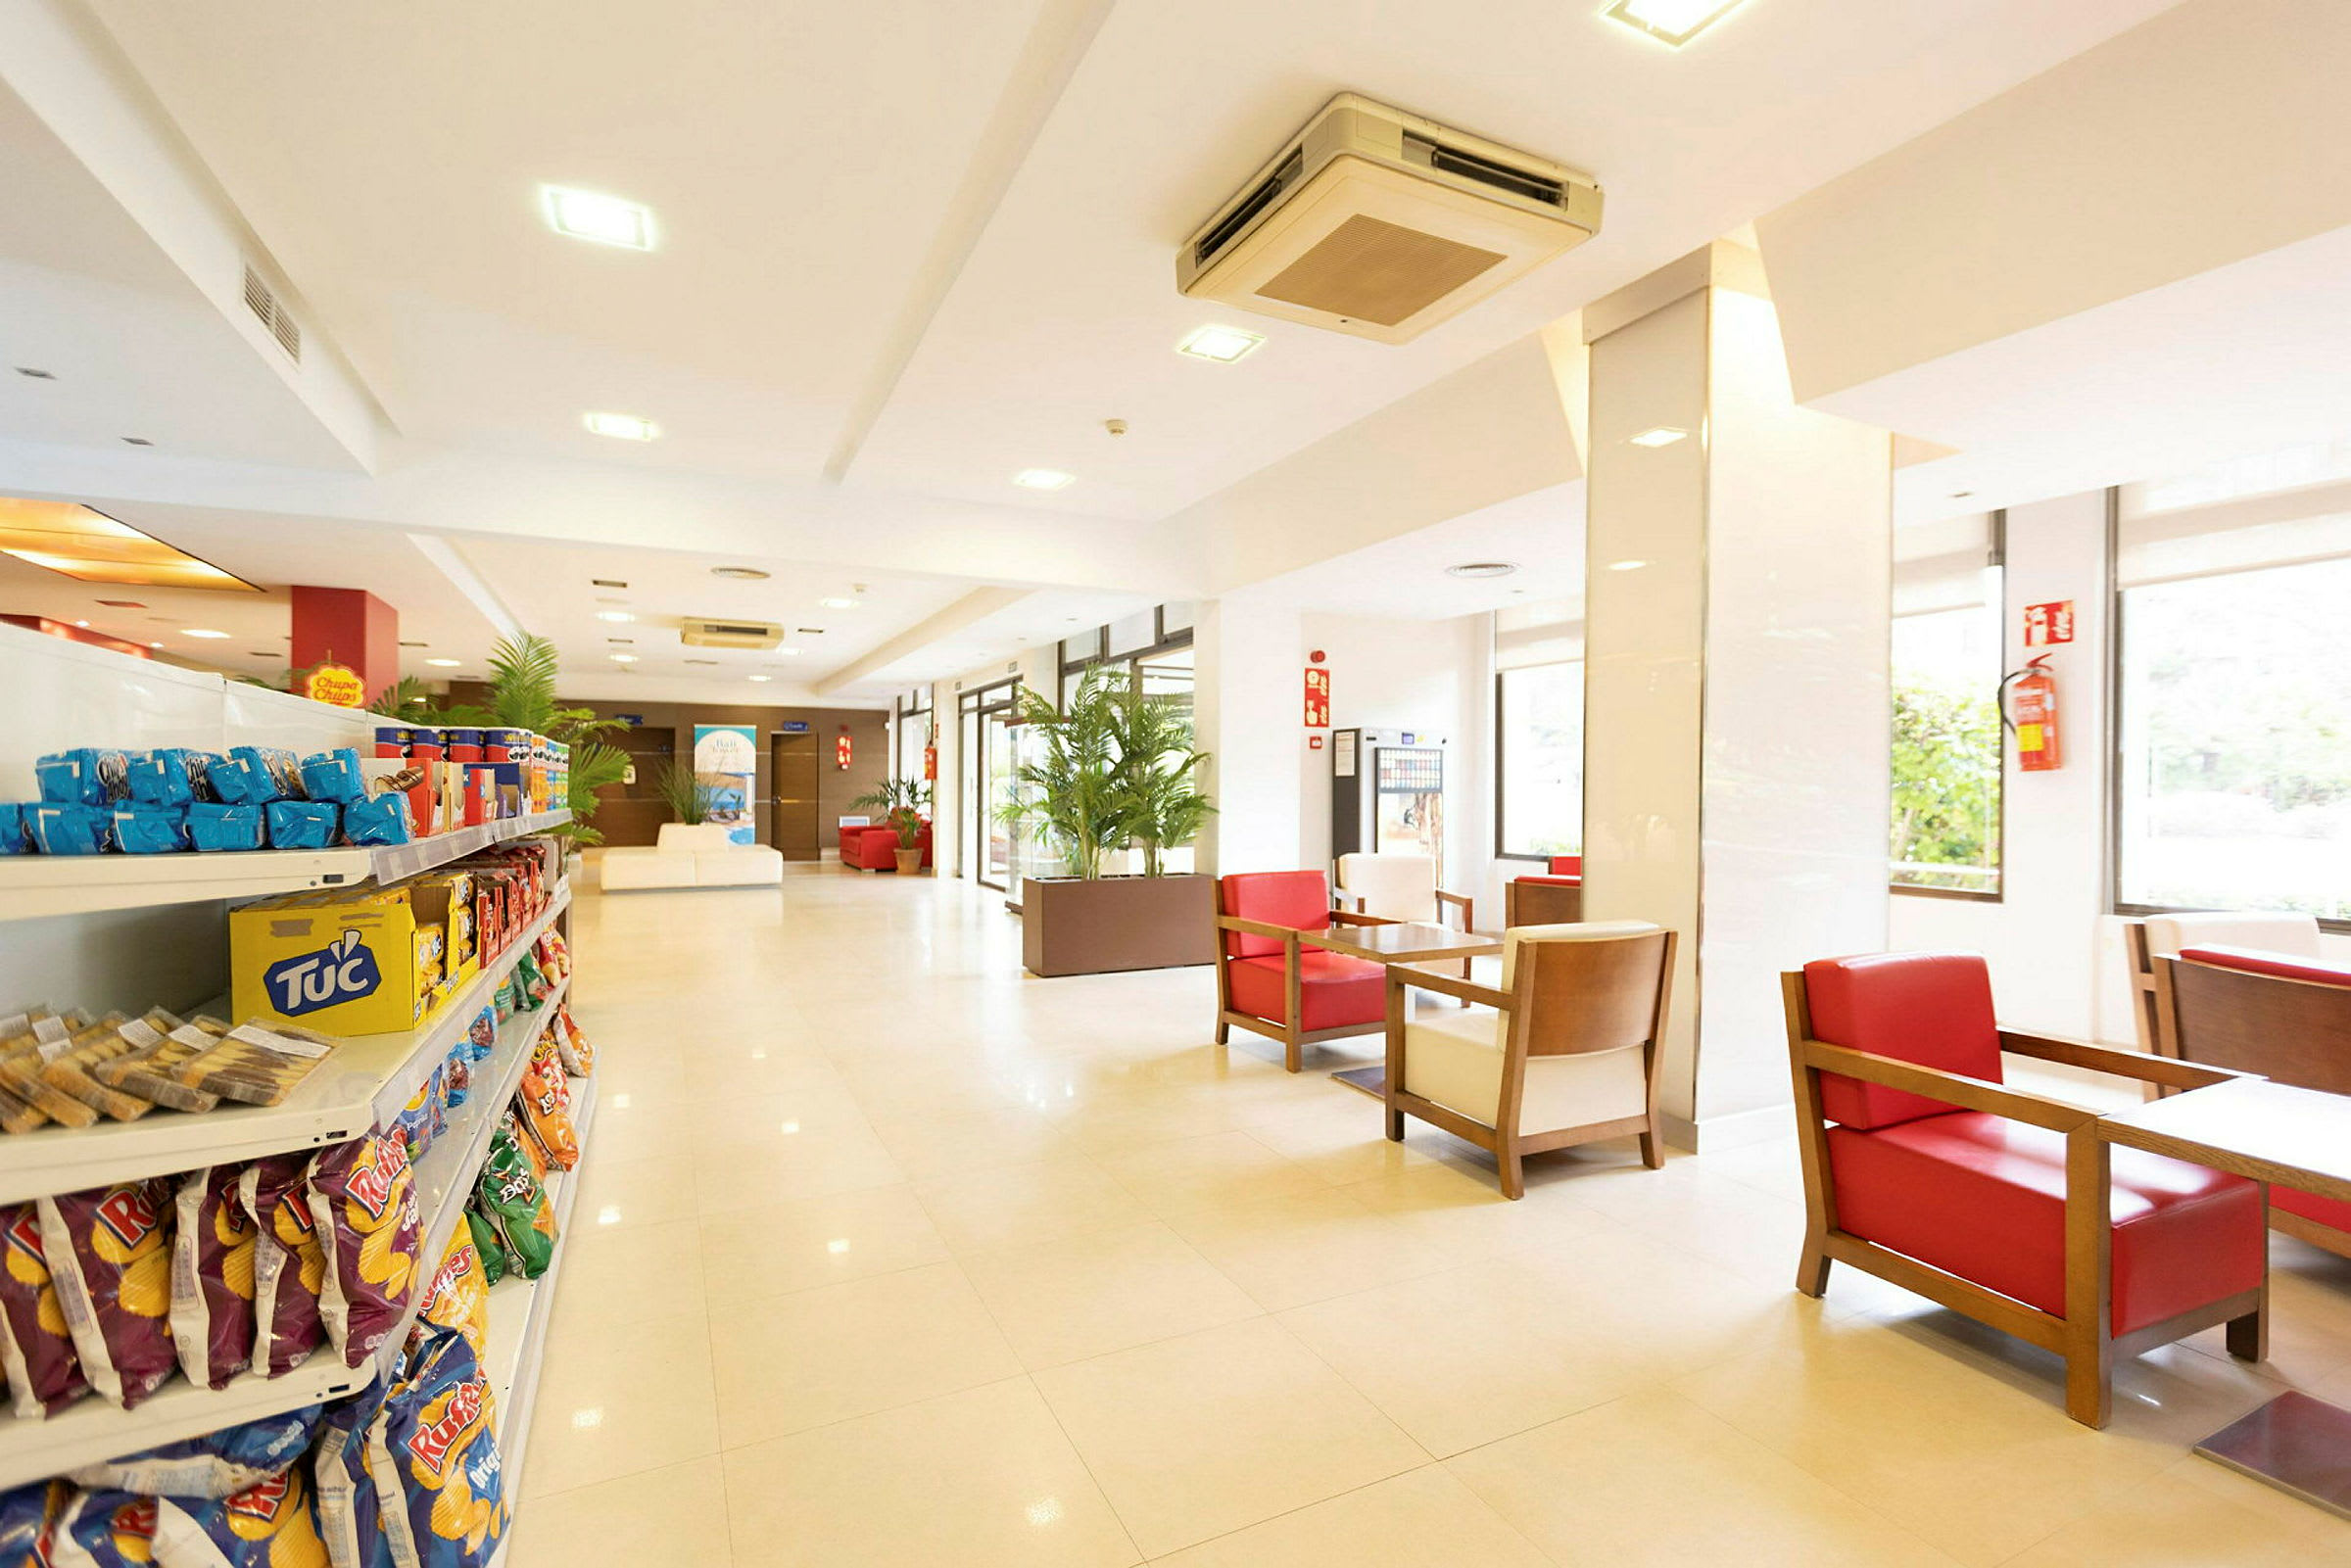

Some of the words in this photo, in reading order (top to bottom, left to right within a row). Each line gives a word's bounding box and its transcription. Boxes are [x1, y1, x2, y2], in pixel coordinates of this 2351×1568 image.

[316, 676, 358, 689] Chupa
[313, 688, 357, 701] Chups
[275, 957, 368, 1010] TUC
